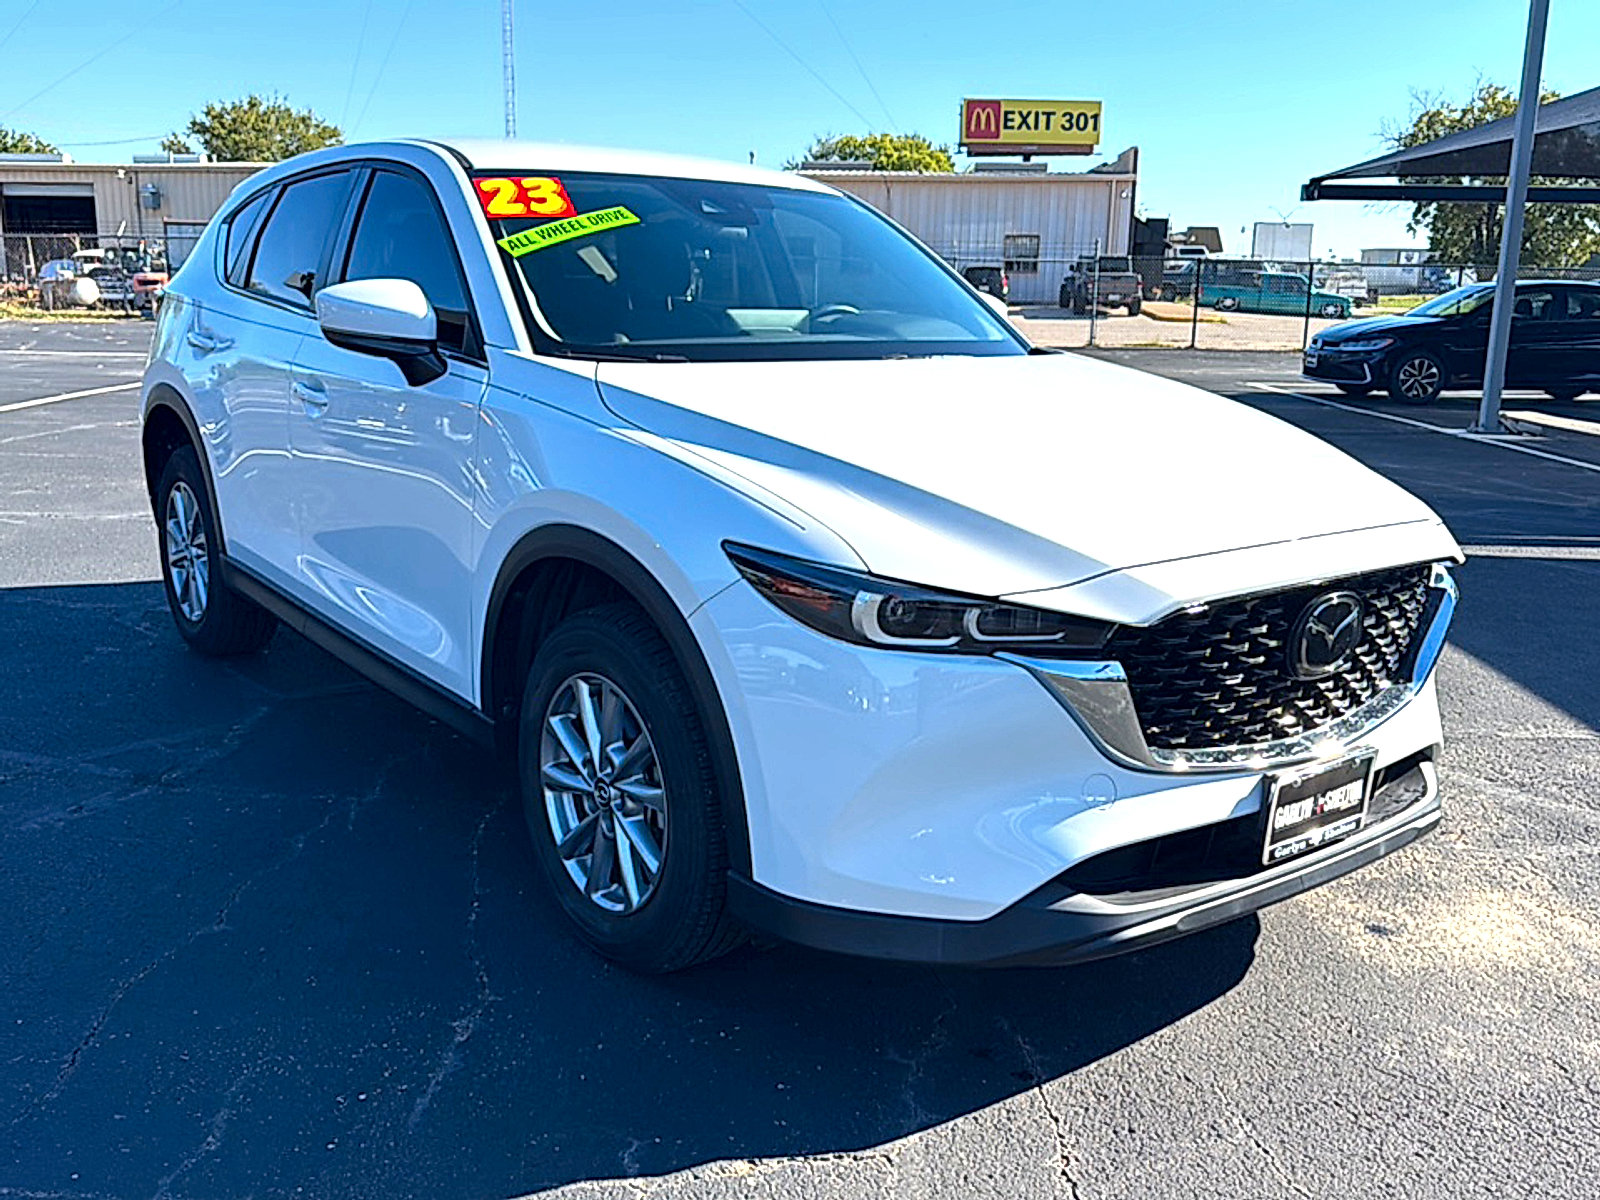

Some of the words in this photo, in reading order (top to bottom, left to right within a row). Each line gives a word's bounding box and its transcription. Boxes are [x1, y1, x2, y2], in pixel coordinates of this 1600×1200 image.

[1003, 111, 1056, 130] EXIT
[1061, 112, 1099, 131] 301
[480, 178, 568, 215] 23
[507, 234, 538, 251] ALL
[535, 220, 588, 241] WHEEL
[590, 209, 629, 226] DRIVE
